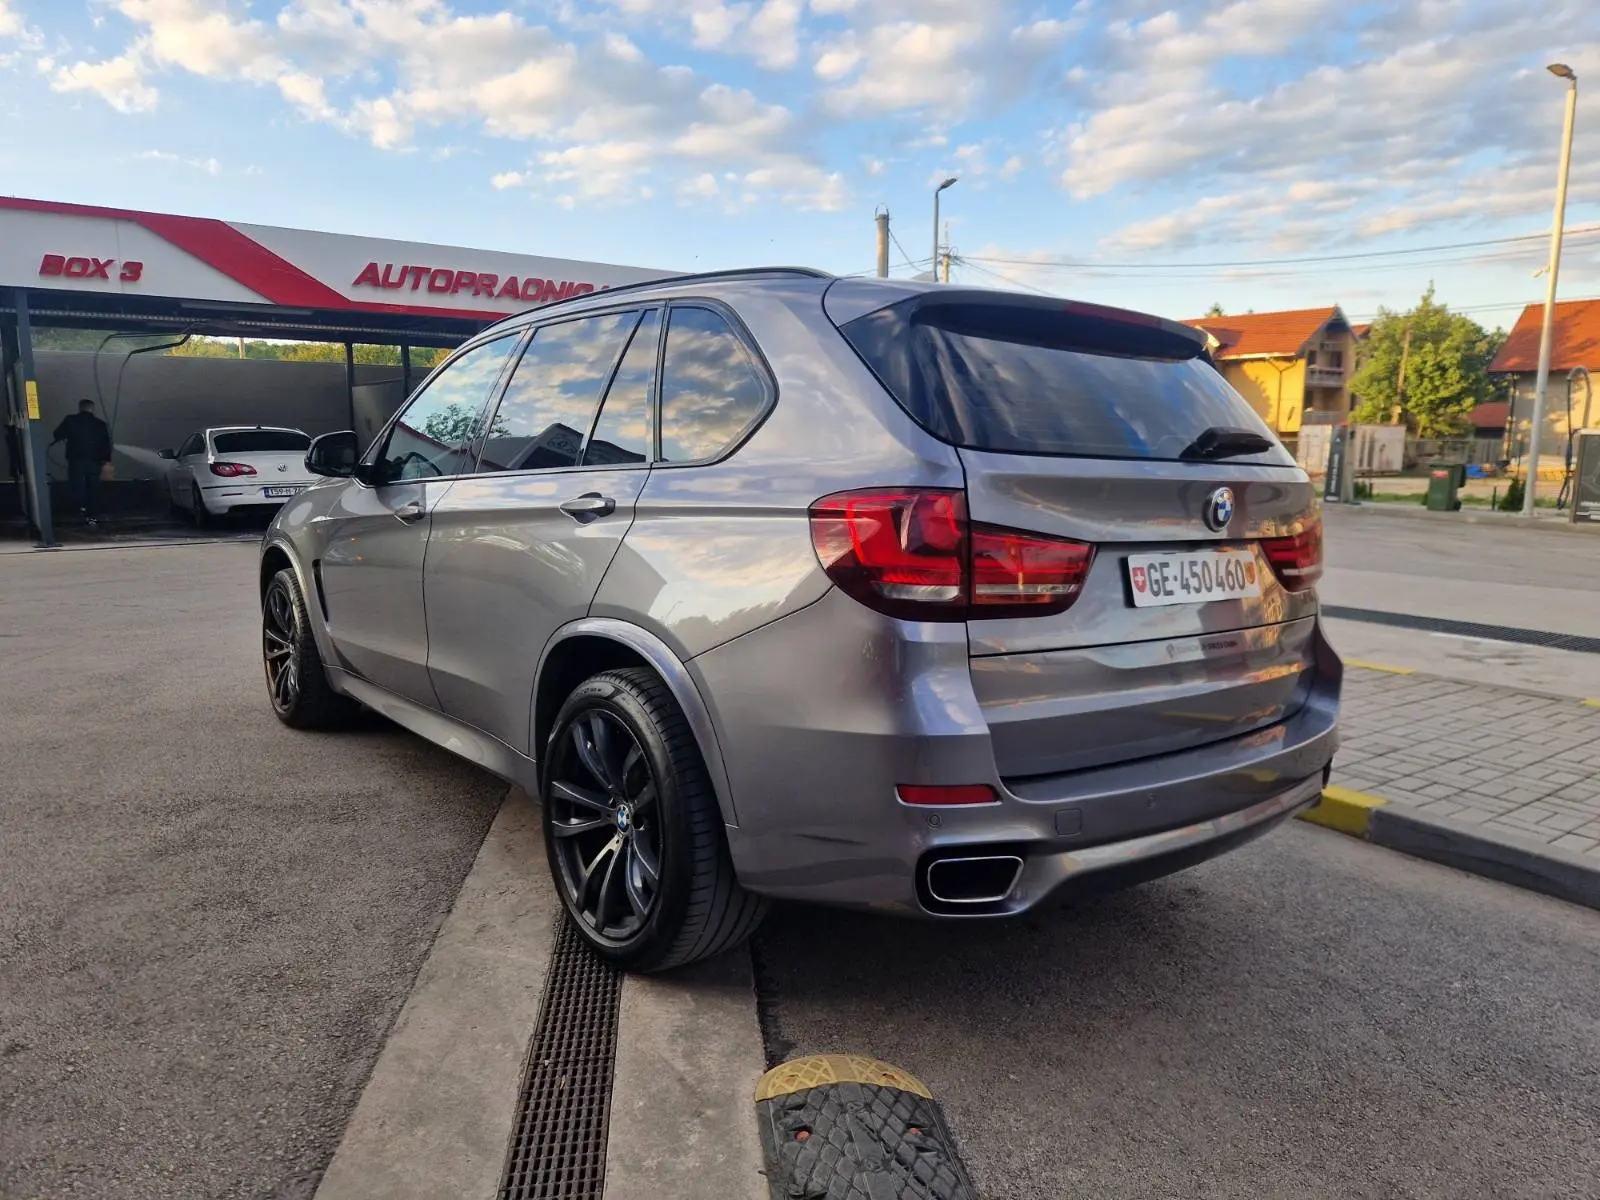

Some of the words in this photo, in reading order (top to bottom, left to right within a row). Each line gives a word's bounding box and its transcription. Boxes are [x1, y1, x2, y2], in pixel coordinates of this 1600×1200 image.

[39, 254, 115, 279] BOX
[120, 261, 143, 281] 3
[352, 261, 609, 301] AUTOPRAONIC
